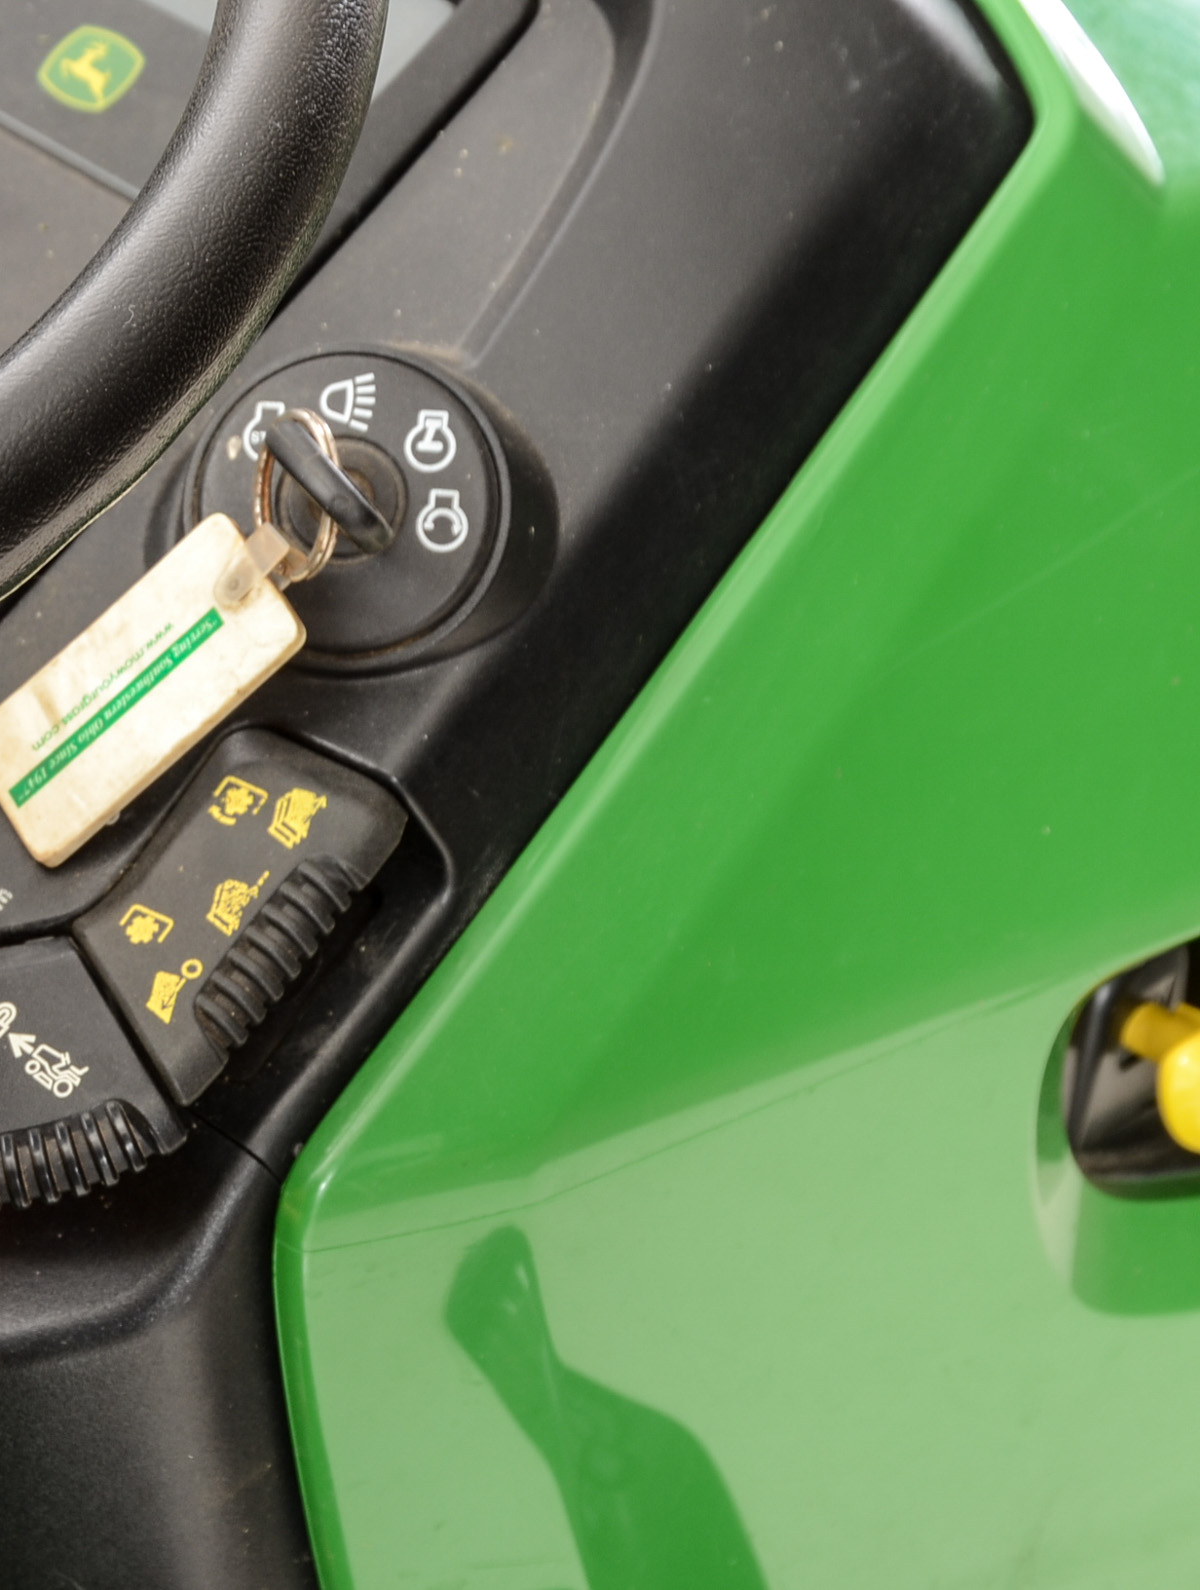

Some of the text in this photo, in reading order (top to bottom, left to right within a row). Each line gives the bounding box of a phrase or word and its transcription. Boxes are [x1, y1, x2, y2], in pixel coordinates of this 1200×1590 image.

[32, 623, 173, 751] www.mowyourgrass.com
[103, 654, 172, 720] Southwestern
[77, 718, 104, 743] Ohio
[48, 740, 78, 769] Since
